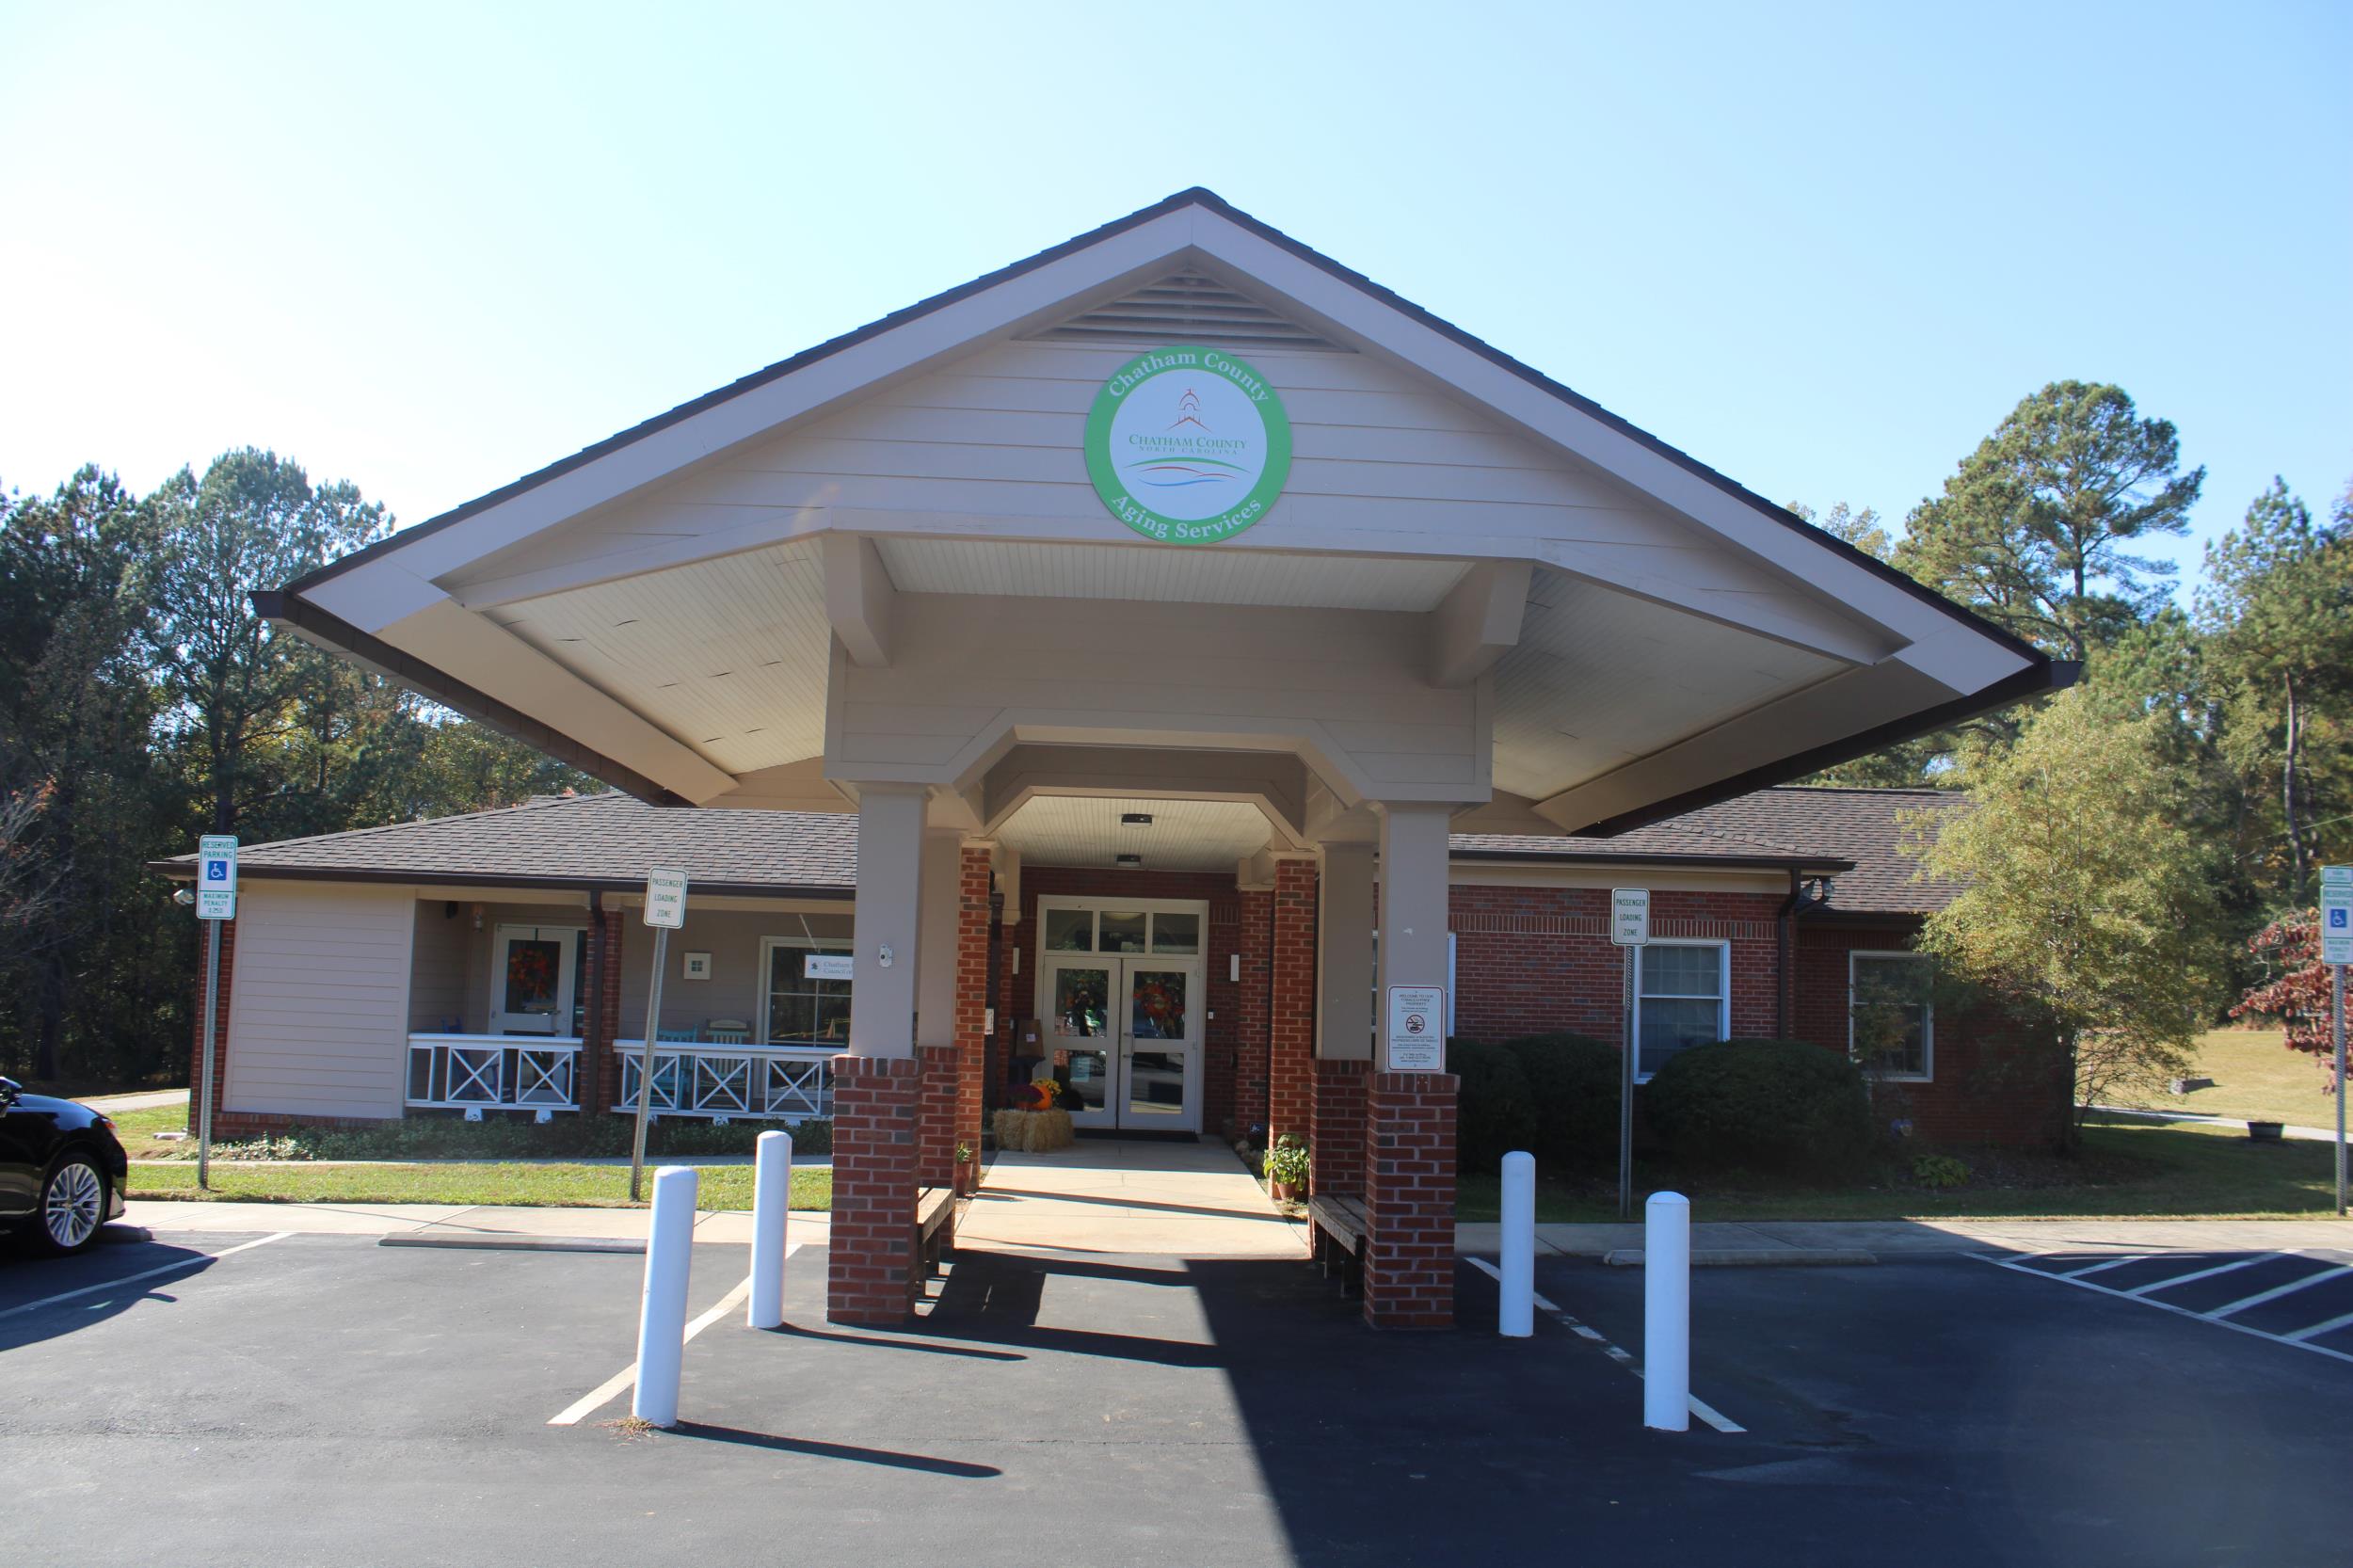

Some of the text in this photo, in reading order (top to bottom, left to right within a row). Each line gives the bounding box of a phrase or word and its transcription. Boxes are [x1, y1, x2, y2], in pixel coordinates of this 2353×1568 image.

[1108, 352, 1269, 402] Chatham County
[1129, 434, 1247, 449] CHATHAM COUNTY
[1182, 447, 1238, 456] CAROLINA
[1112, 496, 1261, 539] Aging Services
[652, 878, 683, 888] PASSENGER
[654, 893, 678, 903] LOADING
[657, 909, 671, 918] ZONE
[1623, 928, 1638, 936] ZONE
